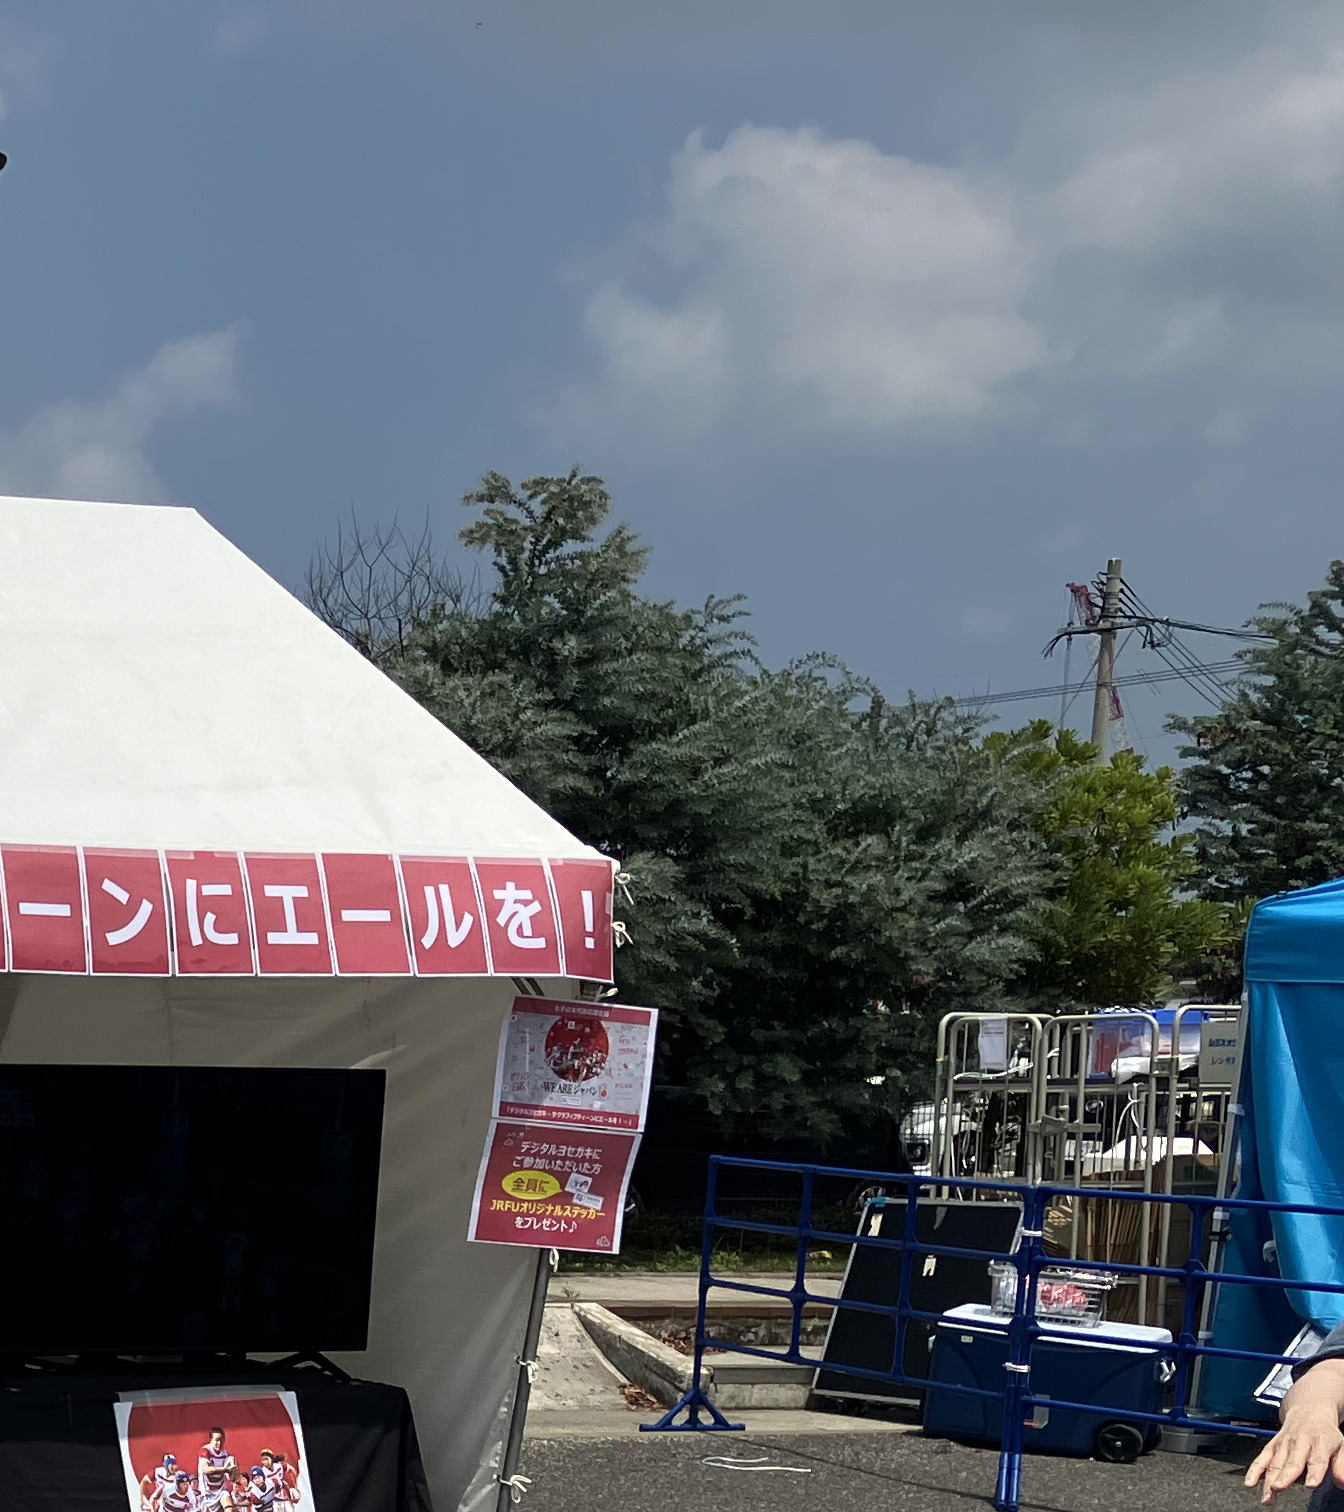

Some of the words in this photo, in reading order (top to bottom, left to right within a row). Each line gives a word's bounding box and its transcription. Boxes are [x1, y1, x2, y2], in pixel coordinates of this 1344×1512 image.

[520, 1141, 602, 1160] デジタルヨセガキに
[512, 1156, 602, 1174] ご参加いただいた方
[512, 1178, 550, 1193] 全員に
[490, 1199, 605, 1219] JRFUオリジナルステッカー
